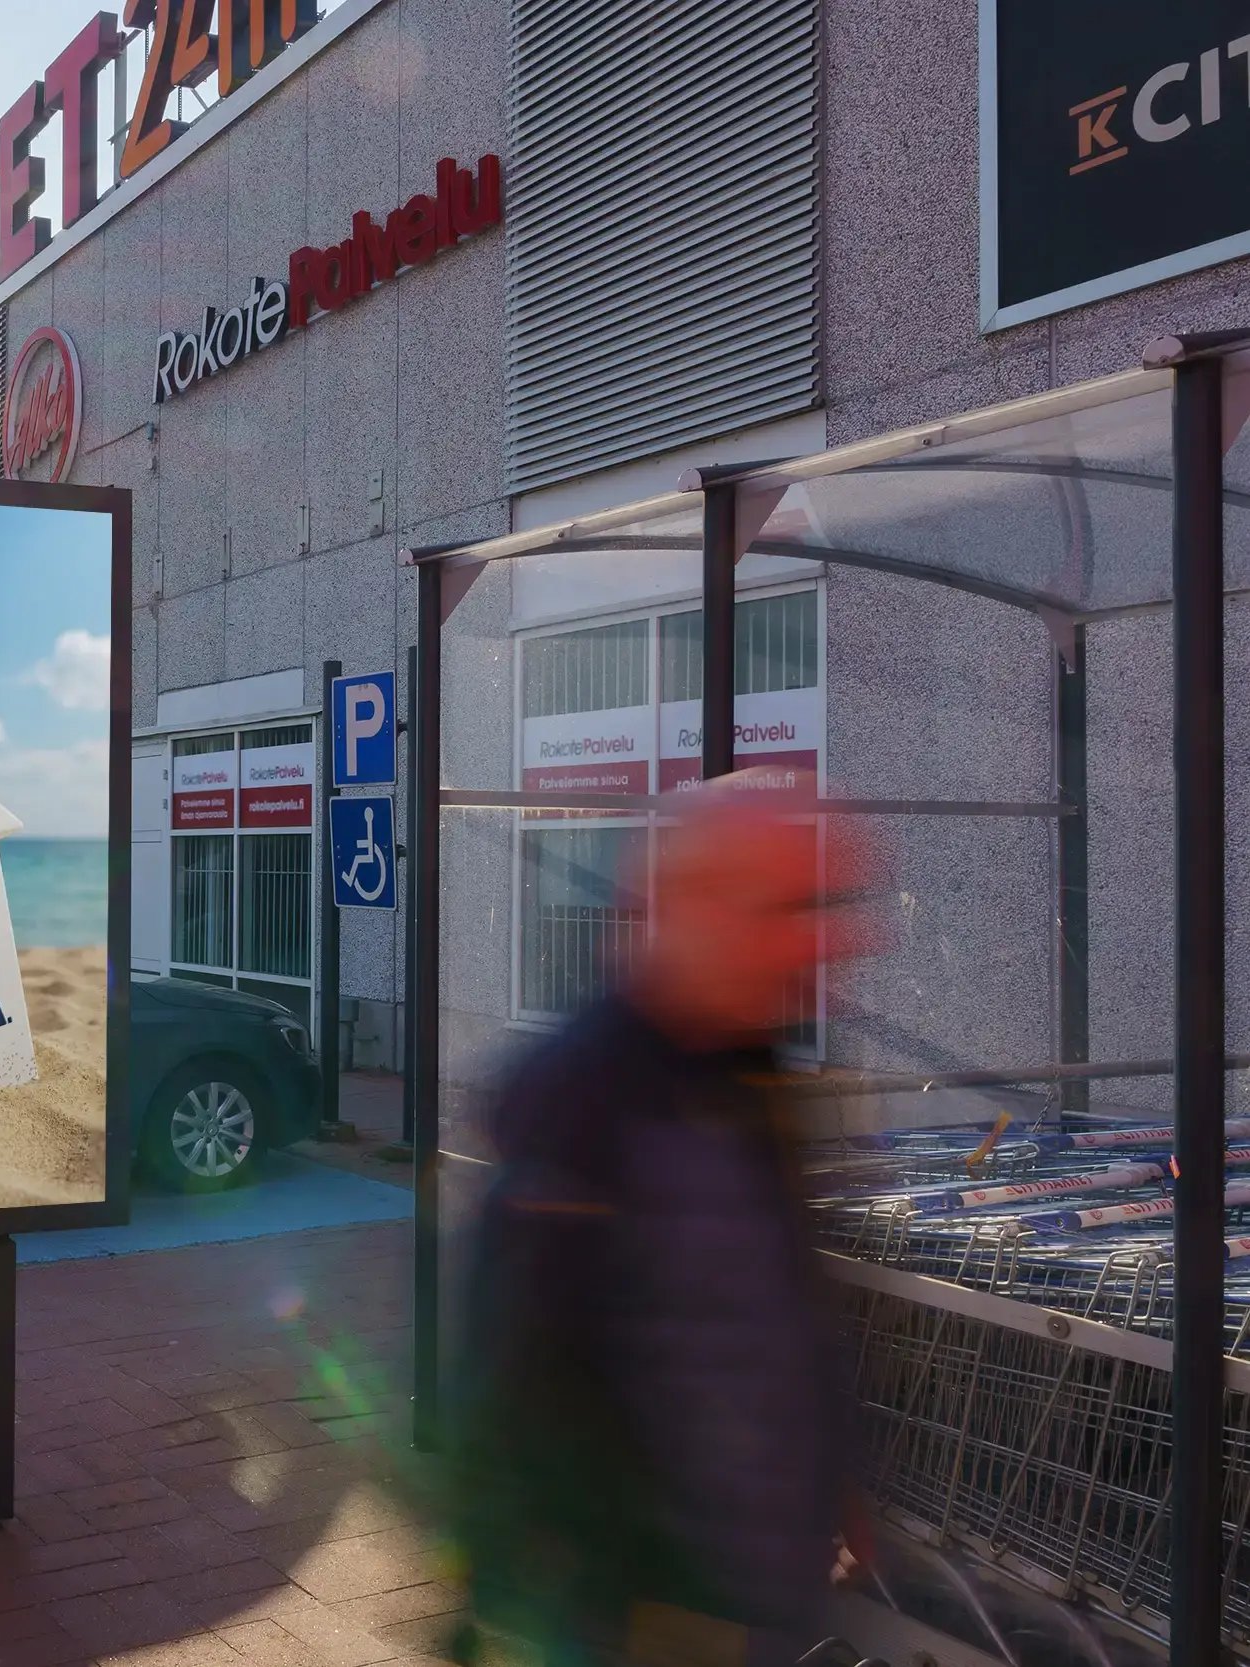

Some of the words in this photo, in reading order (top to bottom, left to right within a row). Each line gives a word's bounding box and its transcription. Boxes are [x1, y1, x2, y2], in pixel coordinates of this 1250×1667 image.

[345, 682, 386, 777] P
[539, 735, 635, 758] RokotePalvelu
[601, 775, 629, 786] sinua
